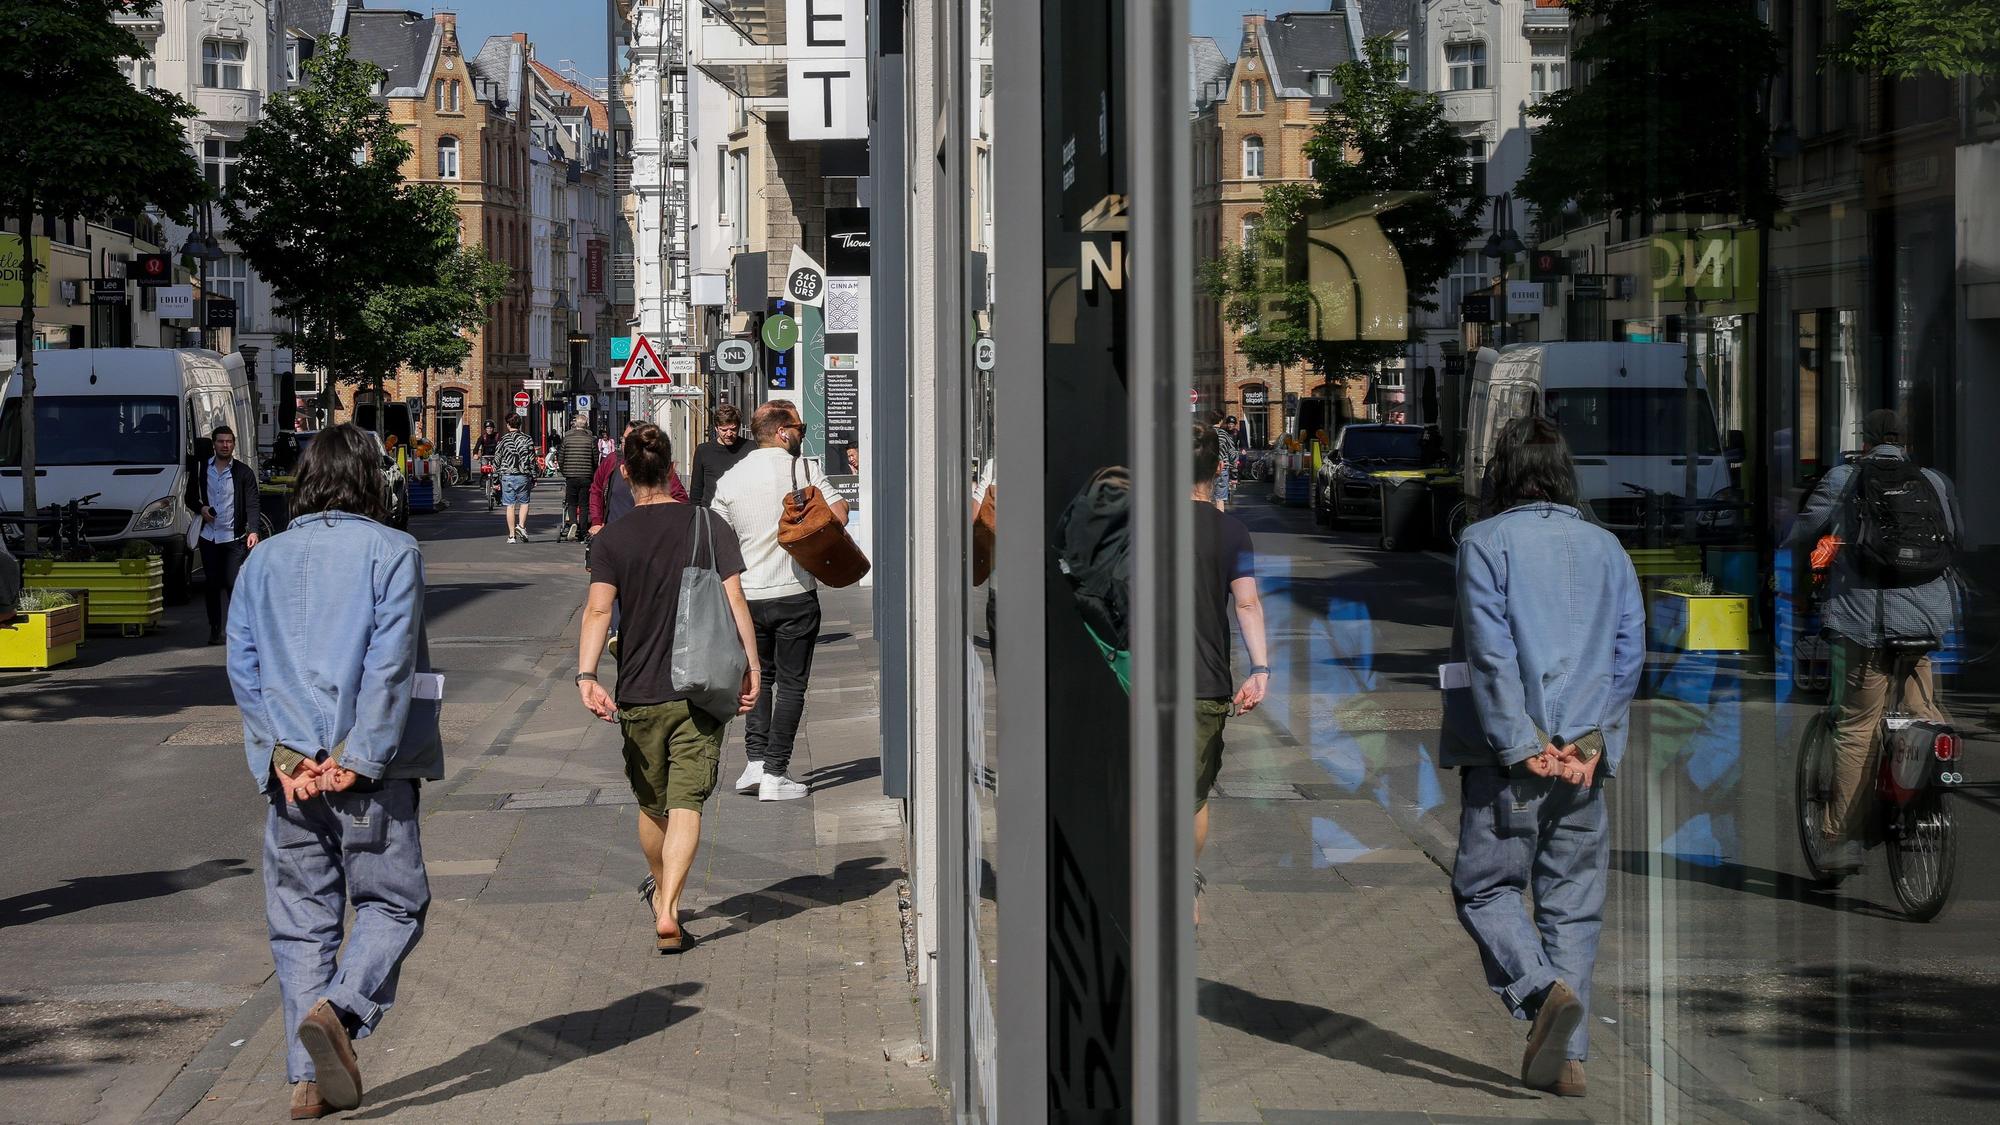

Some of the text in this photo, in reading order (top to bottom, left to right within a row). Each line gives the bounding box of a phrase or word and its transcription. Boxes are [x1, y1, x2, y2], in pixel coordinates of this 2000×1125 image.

[1081, 241, 1130, 289] N
[797, 272, 817, 282] 24C
[103, 281, 117, 289] Lee
[795, 280, 816, 289] OLO
[794, 287, 814, 297] URS
[775, 300, 787, 387] PING
